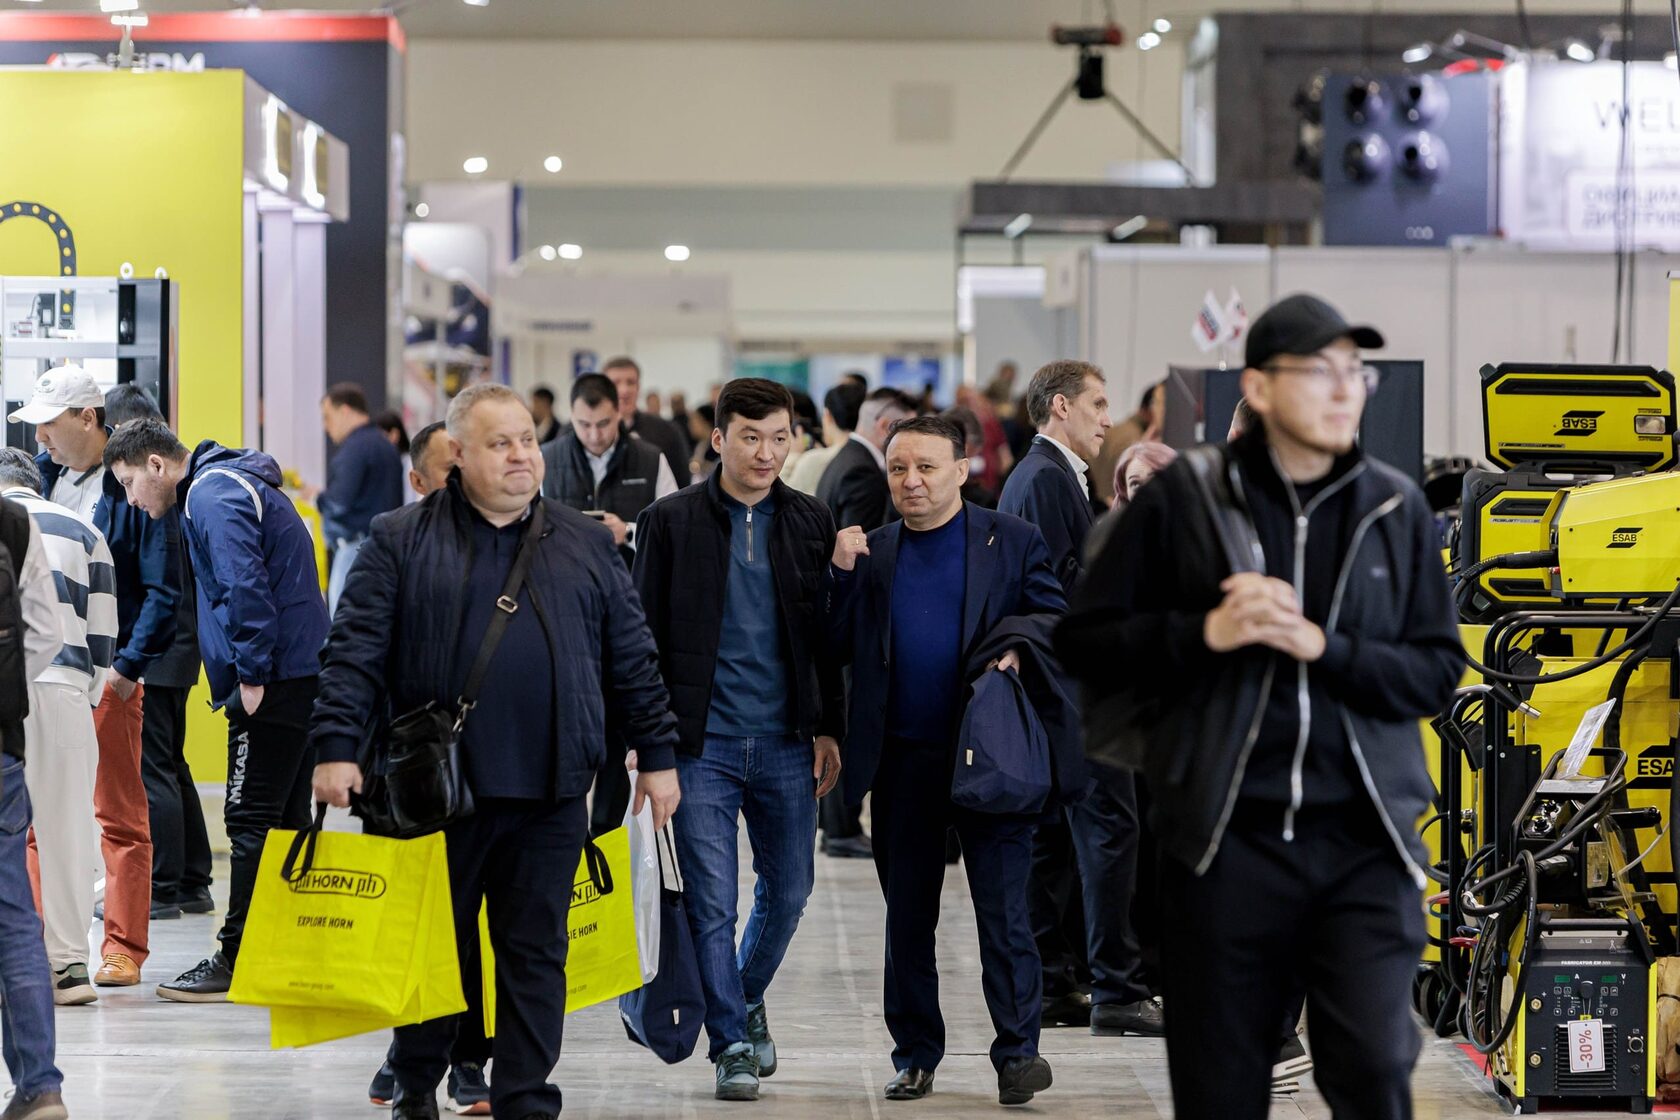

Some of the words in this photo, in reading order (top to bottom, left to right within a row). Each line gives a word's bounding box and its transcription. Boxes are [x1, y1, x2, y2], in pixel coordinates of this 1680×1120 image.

[1562, 418, 1597, 428] ESAB
[1612, 534, 1637, 542] ESAB
[312, 875, 353, 890] HORN
[297, 915, 327, 928] EXPLORE
[328, 917, 353, 929] HORN
[579, 921, 598, 938] HORN
[1579, 1029, 1593, 1068] -30%
